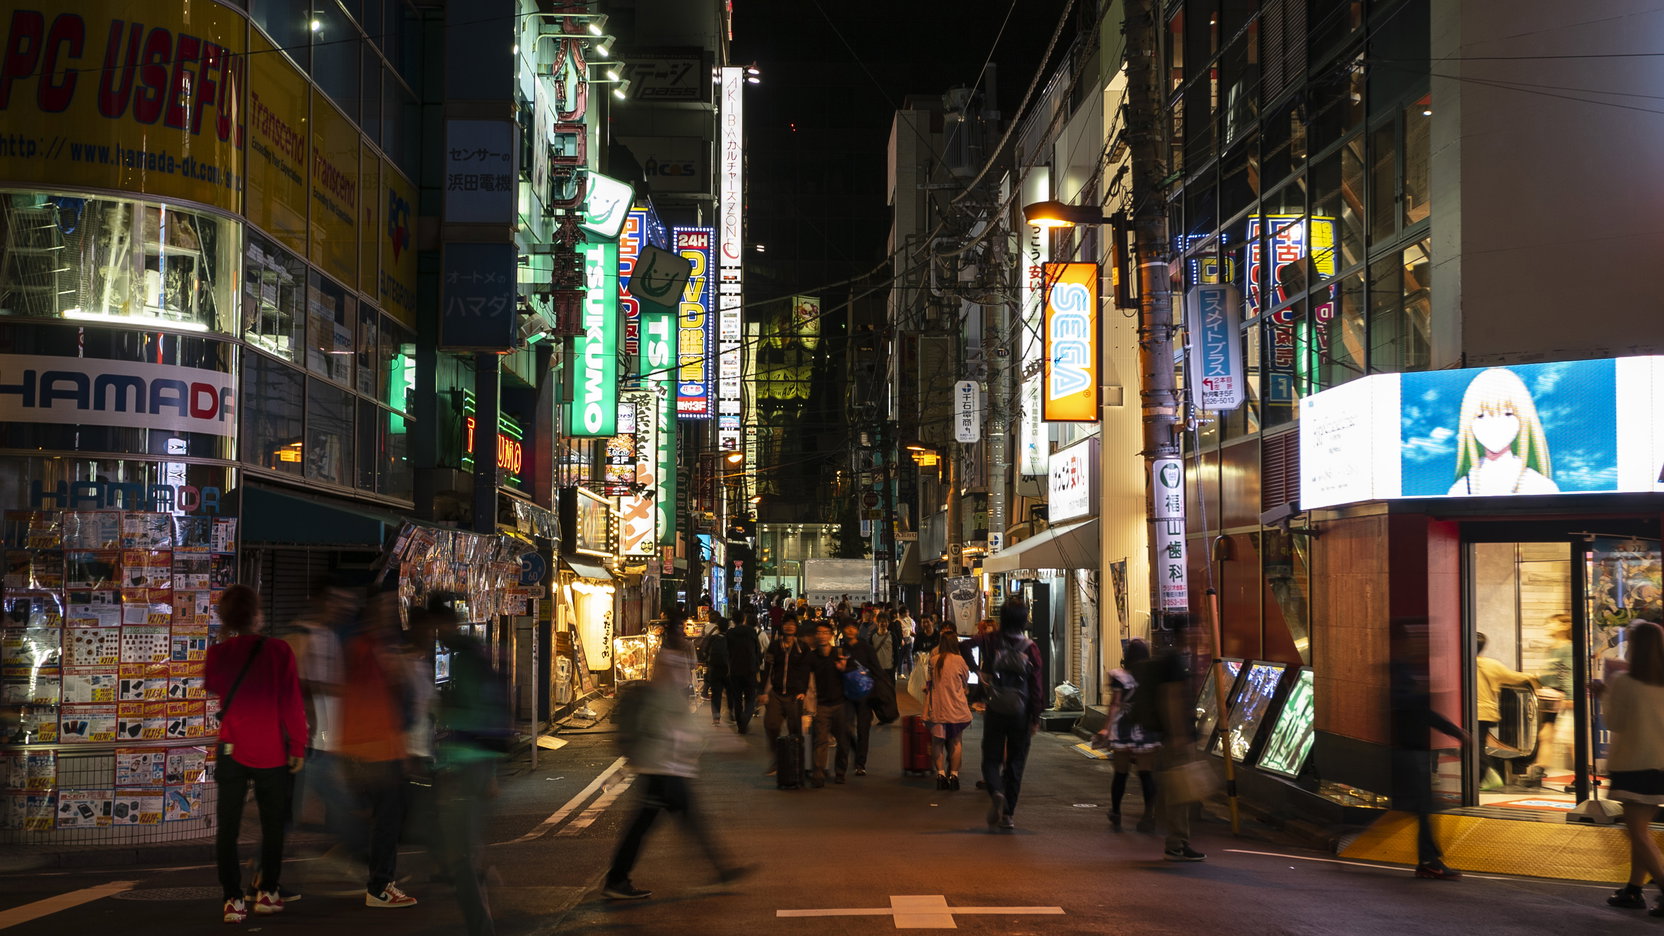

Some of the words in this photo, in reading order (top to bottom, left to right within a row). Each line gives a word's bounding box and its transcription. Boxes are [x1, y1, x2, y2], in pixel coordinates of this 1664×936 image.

[0, 9, 86, 113] PC
[97, 18, 244, 151] USEFUL
[250, 91, 305, 168] Transcend
[312, 146, 356, 210] Transcend
[448, 147, 510, 163] センサーの
[446, 173, 513, 193] 浜田電機
[678, 234, 707, 247] 24H
[446, 293, 509, 319] ハマダ
[583, 245, 604, 434] TSUKUMO
[1050, 281, 1092, 402] SEGA
[1204, 290, 1227, 375] コスメイトプラス
[612, 456, 629, 465] 2F
[31, 479, 221, 514] HAMADA
[1165, 494, 1184, 583] 福山歯科
[520, 560, 532, 582] P
